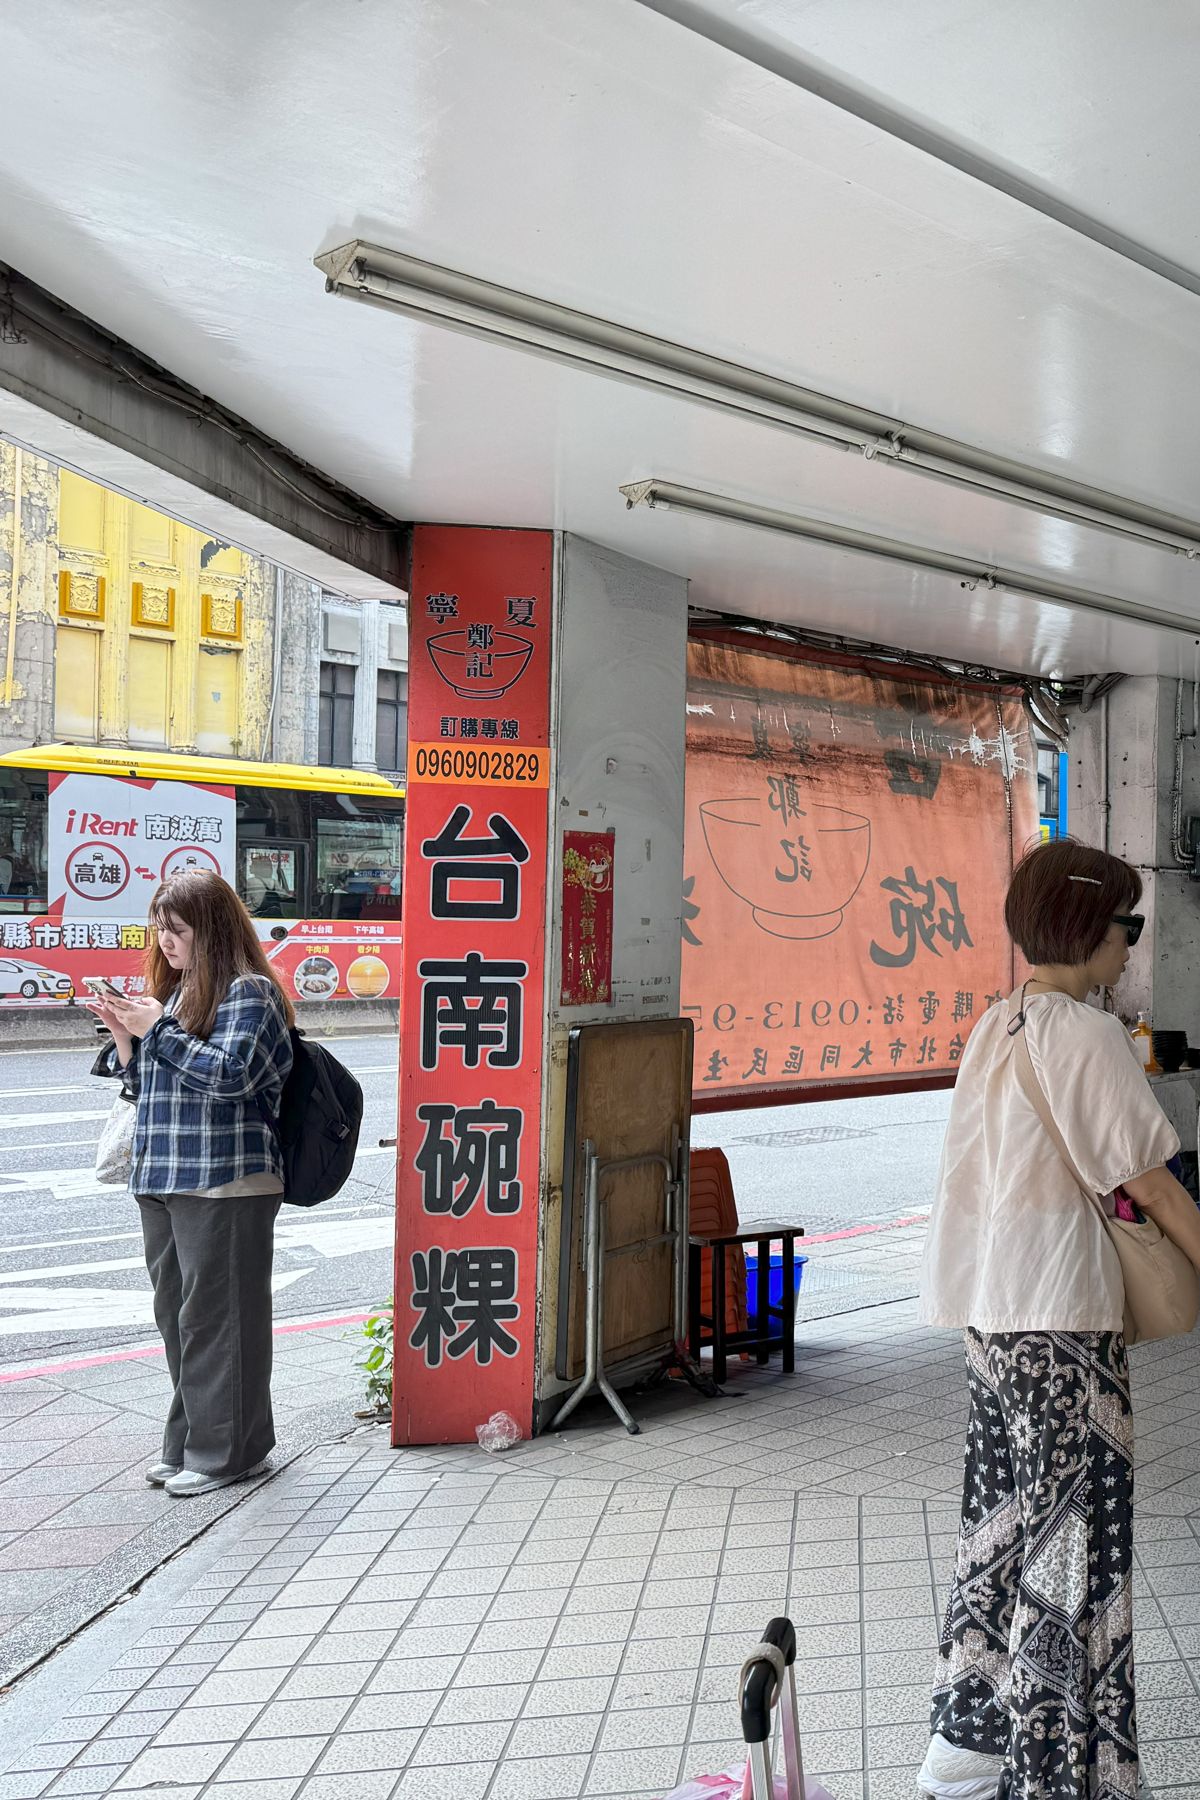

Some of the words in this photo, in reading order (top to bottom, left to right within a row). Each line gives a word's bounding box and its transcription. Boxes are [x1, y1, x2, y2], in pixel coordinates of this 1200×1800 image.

[425, 593, 537, 628] 寧夏
[465, 623, 495, 679] 鄭記
[440, 716, 520, 740] 訂購專線
[415, 748, 540, 782] 0960902829
[145, 814, 223, 843] 南波萬
[74, 863, 121, 884] 高雄
[0, 922, 157, 950] 縣市租還南
[409, 802, 531, 1367] 台南碗粿
